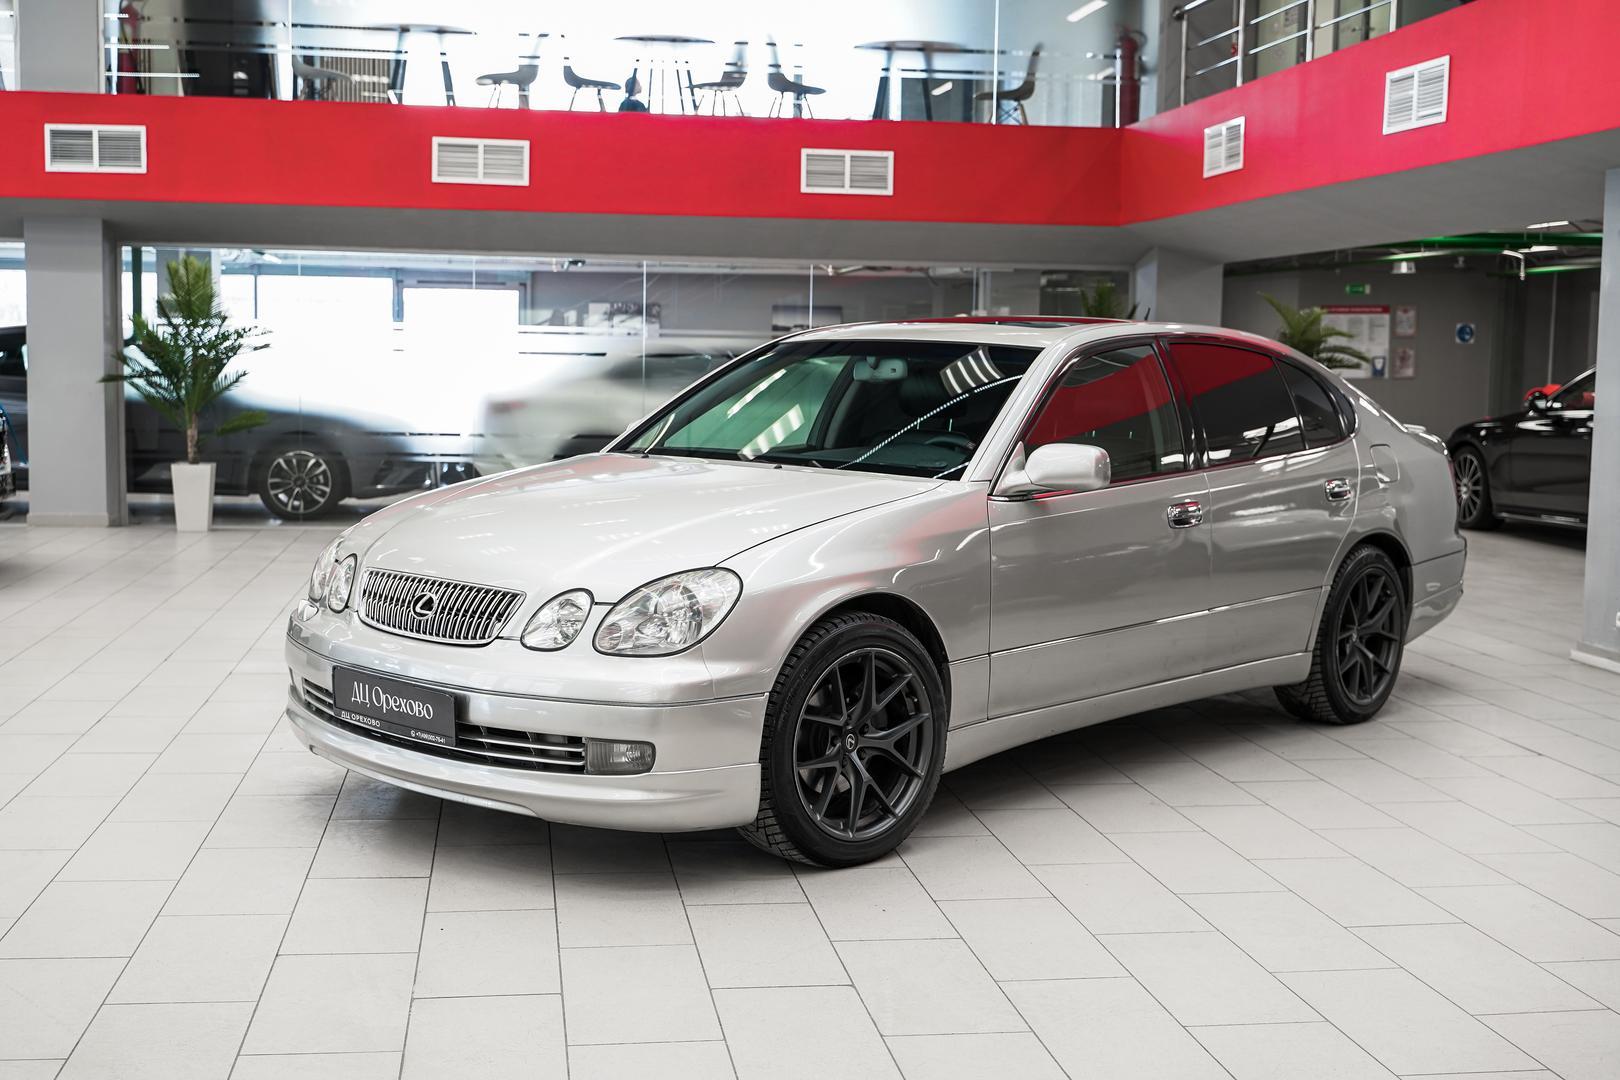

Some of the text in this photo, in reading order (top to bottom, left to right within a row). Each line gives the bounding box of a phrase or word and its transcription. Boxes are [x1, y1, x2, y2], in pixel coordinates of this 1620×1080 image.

[351, 681, 433, 719] ДЦ Орехово
[341, 711, 380, 727] ДЦ ОРЕХОВО
